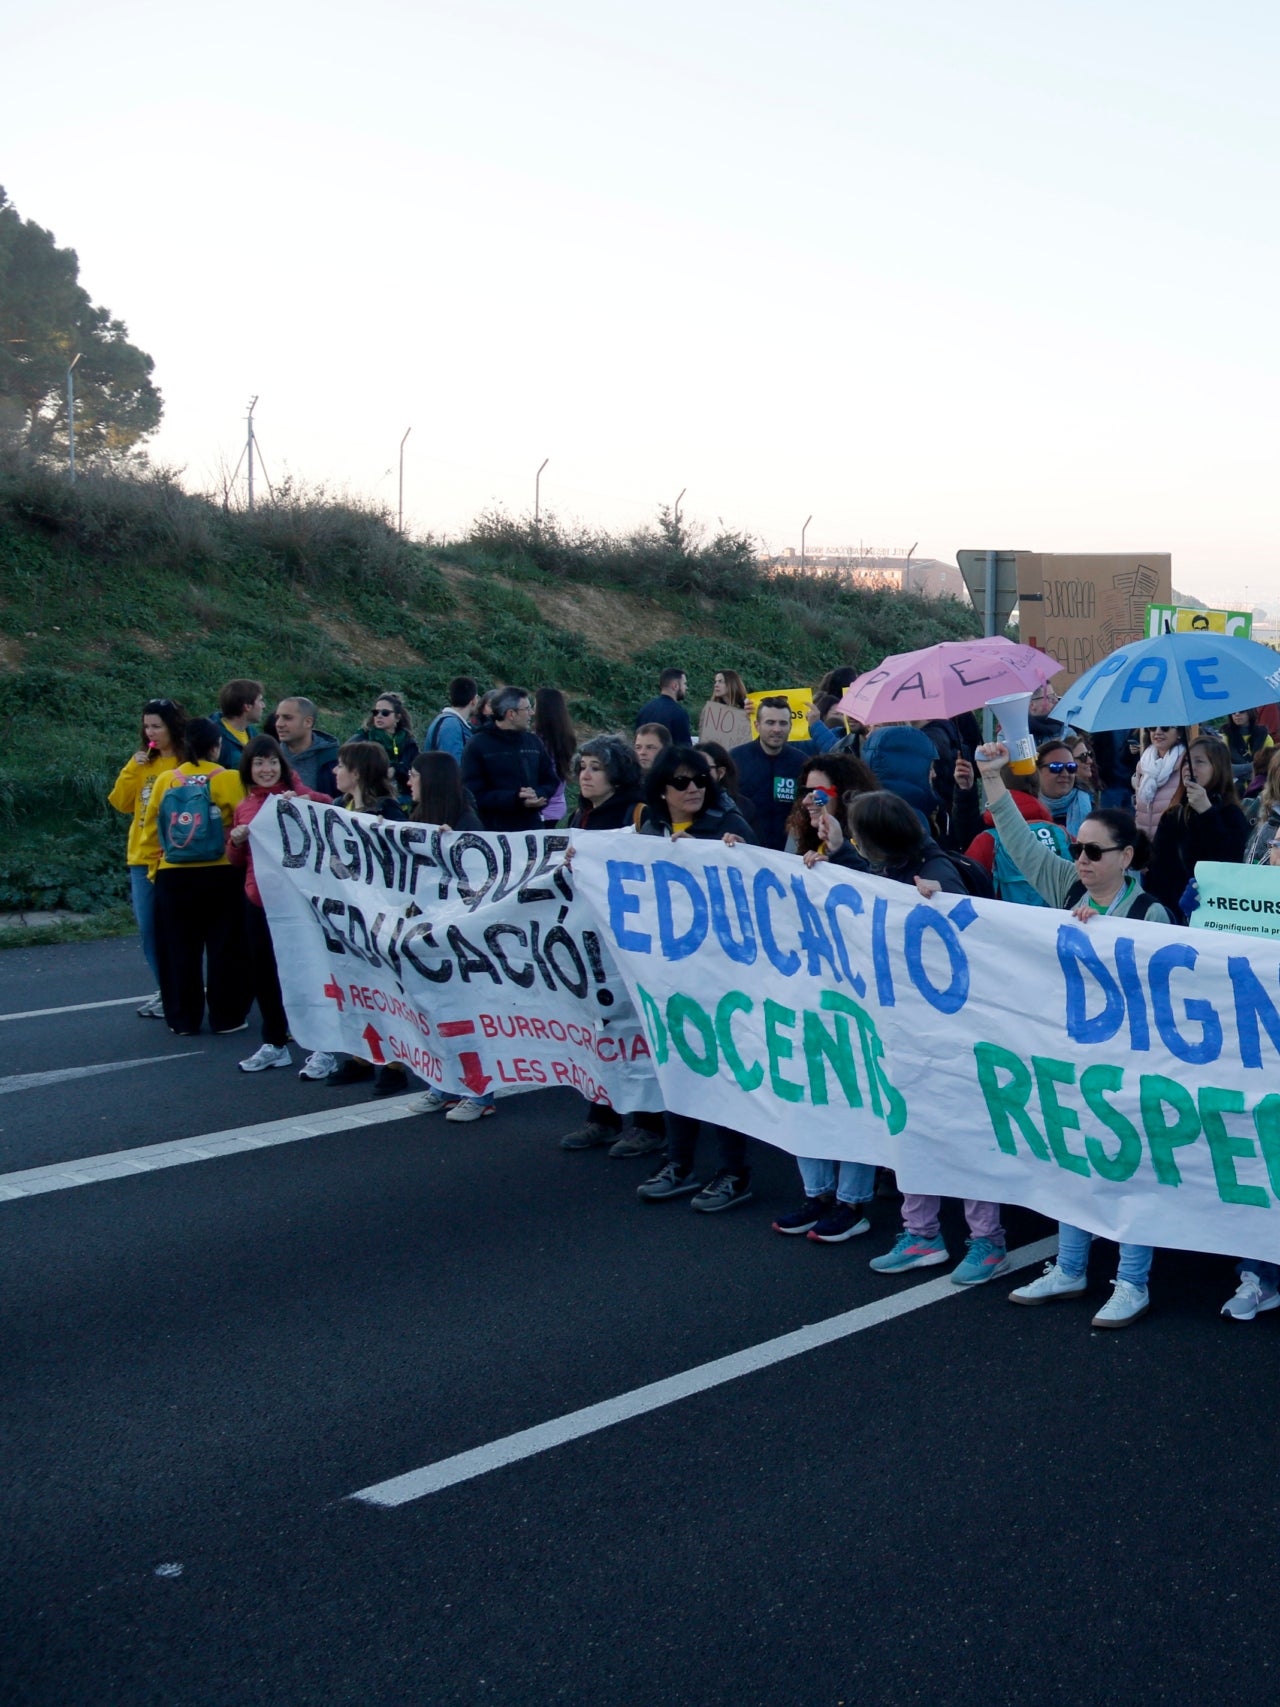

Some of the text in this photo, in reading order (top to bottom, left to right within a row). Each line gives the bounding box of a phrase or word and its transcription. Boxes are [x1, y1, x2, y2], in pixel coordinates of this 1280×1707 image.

[855, 658, 990, 701] PAE
[1079, 654, 1229, 704] PAE
[705, 706, 735, 733] NO
[777, 778, 795, 789] JO
[606, 859, 979, 1015] EDUCACIÓ
[1204, 920, 1259, 933] #Dignifiquem
[1261, 926, 1269, 934] la
[389, 1036, 443, 1083] SALARIS
[497, 1058, 548, 1083] LES
[637, 983, 907, 1136] DOCENTS
